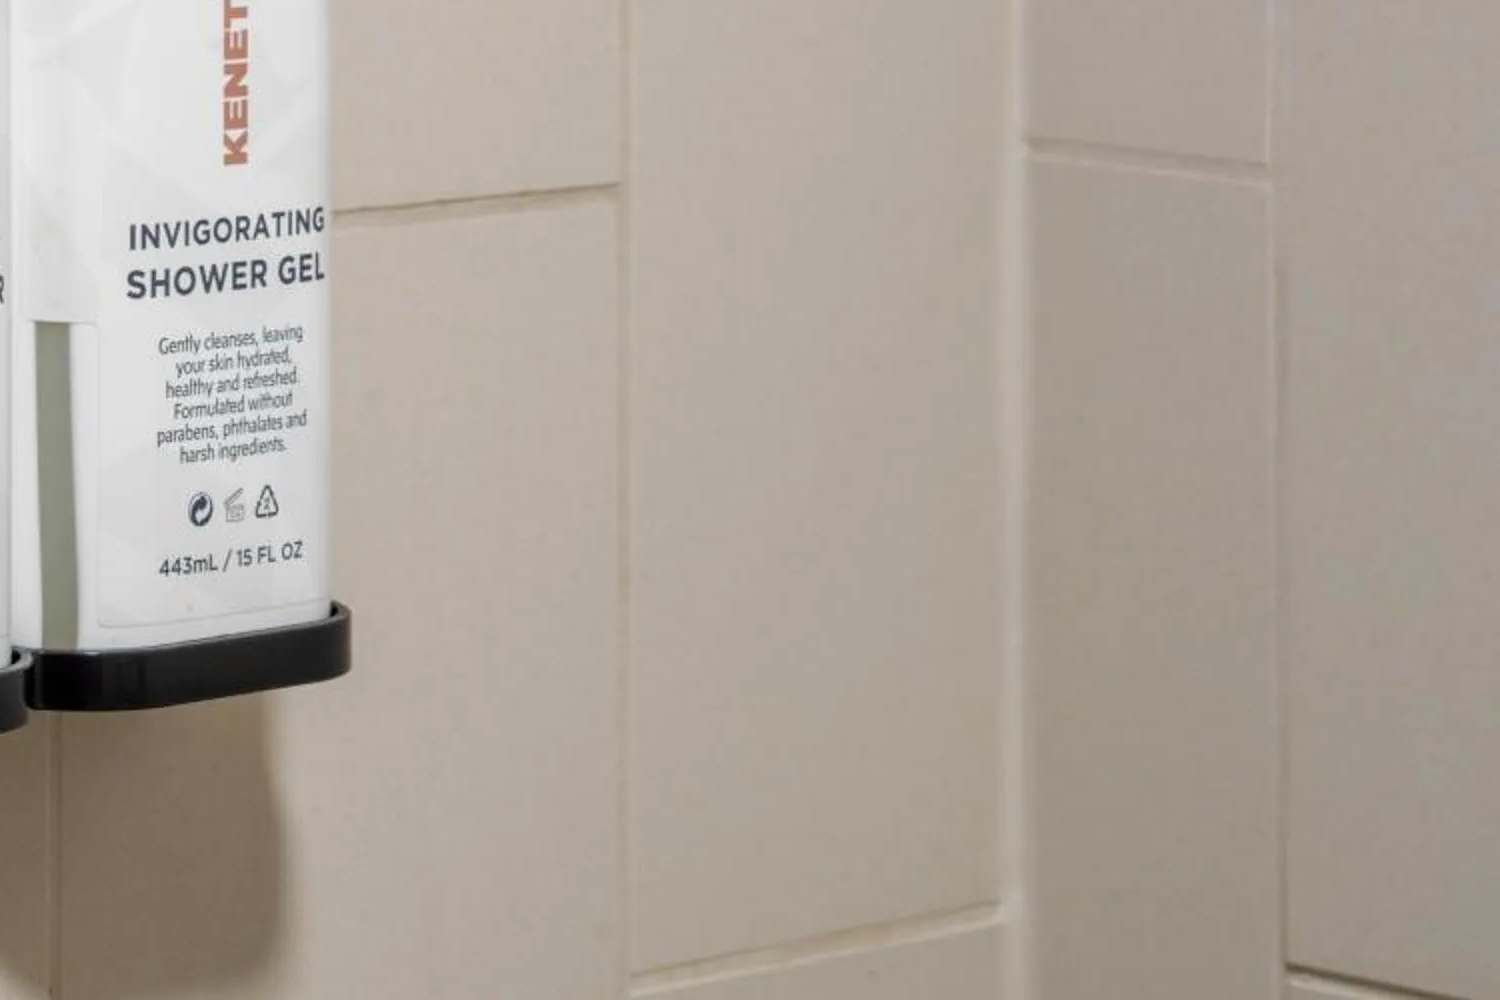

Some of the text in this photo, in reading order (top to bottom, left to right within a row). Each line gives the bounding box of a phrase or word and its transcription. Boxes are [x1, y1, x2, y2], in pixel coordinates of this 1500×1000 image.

[130, 206, 325, 250] INVIGORATING
[127, 252, 325, 299] SHOWER GEL
[158, 334, 201, 355] Gently
[262, 326, 303, 346] leaving
[176, 360, 206, 379] your
[208, 353, 234, 373] skin
[165, 377, 214, 398] healthy
[216, 373, 240, 393] and
[173, 390, 293, 420] Formulated without
[157, 409, 307, 448] parabens, phthalates and
[179, 436, 288, 463] harsh ingredients.
[159, 540, 303, 576] 443mL / 15 FL OZ
